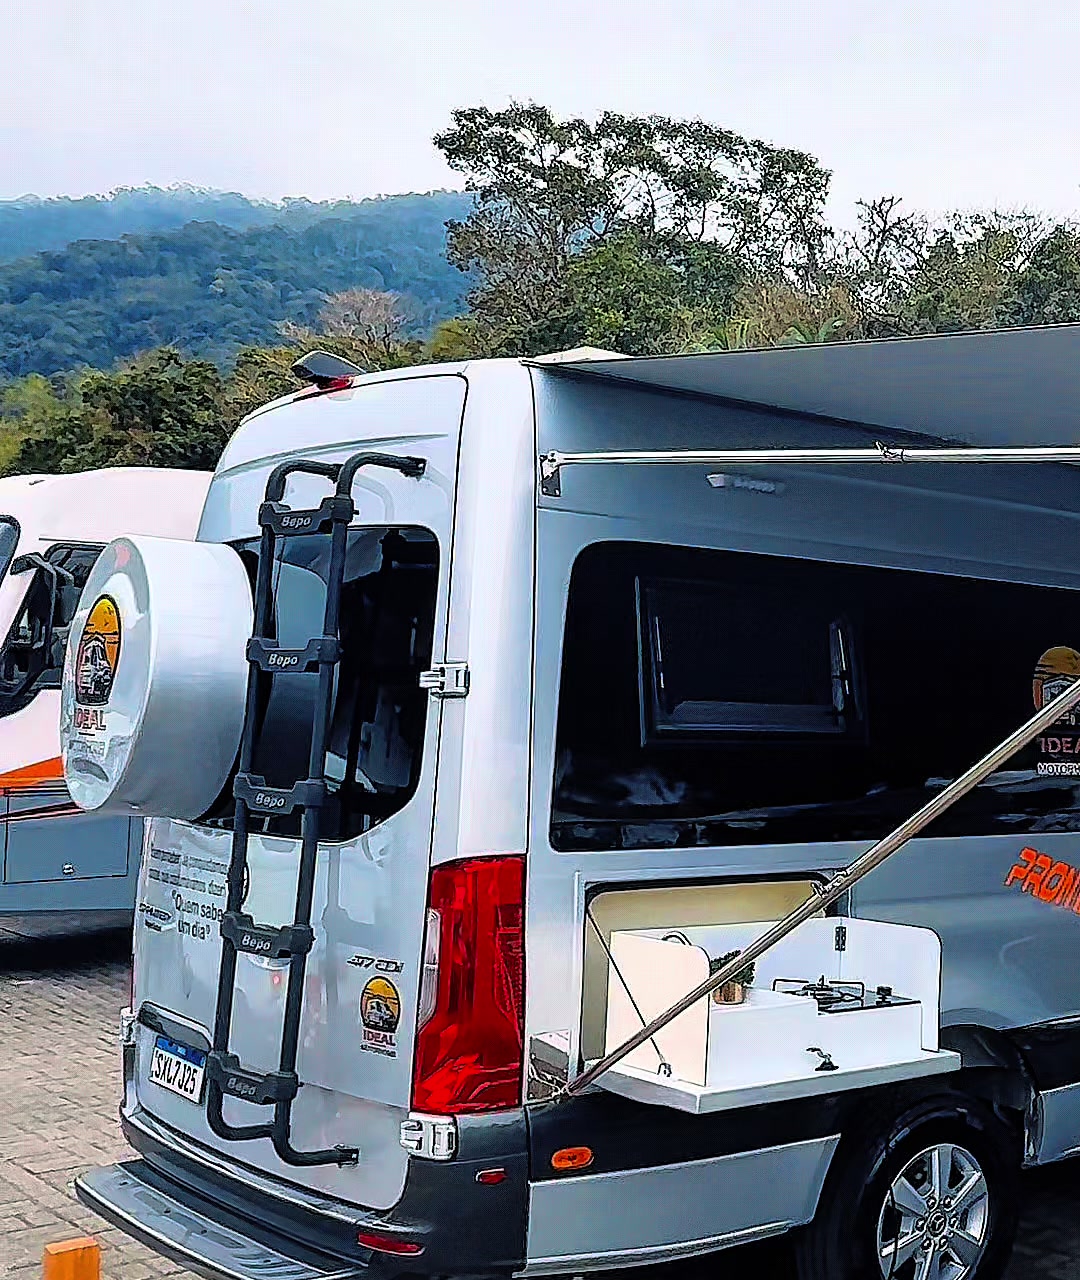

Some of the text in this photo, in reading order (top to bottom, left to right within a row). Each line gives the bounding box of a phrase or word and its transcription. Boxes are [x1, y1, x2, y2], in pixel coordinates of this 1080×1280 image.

[281, 516, 311, 529] Bepo
[268, 653, 298, 669] Bepo
[255, 792, 285, 808] Bepo
[241, 933, 271, 951] Bepo
[362, 1028, 397, 1047] IDEAL
